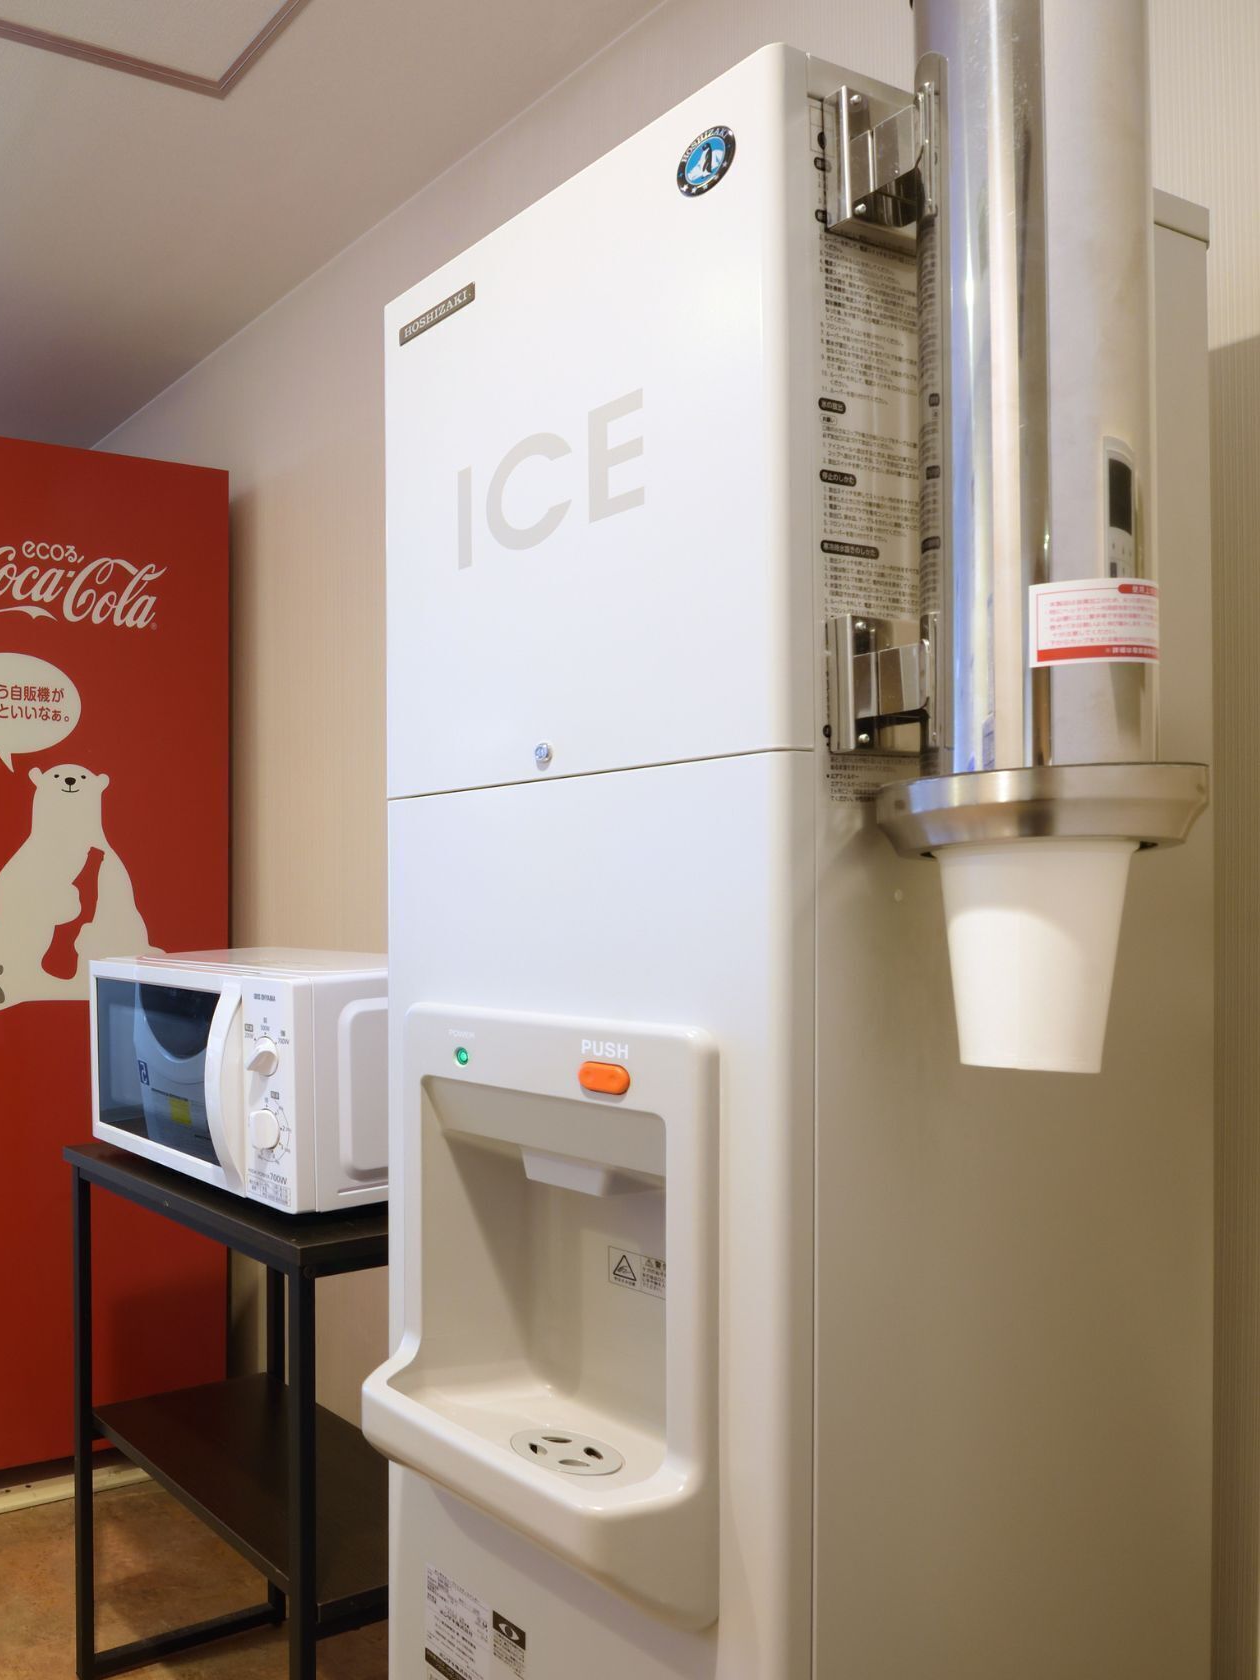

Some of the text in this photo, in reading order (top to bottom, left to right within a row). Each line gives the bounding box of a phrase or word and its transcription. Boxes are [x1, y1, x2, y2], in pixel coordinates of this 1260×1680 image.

[403, 289, 468, 338] HOSHIZAKI
[458, 387, 645, 571] ICE
[581, 1039, 629, 1059] PUSH
